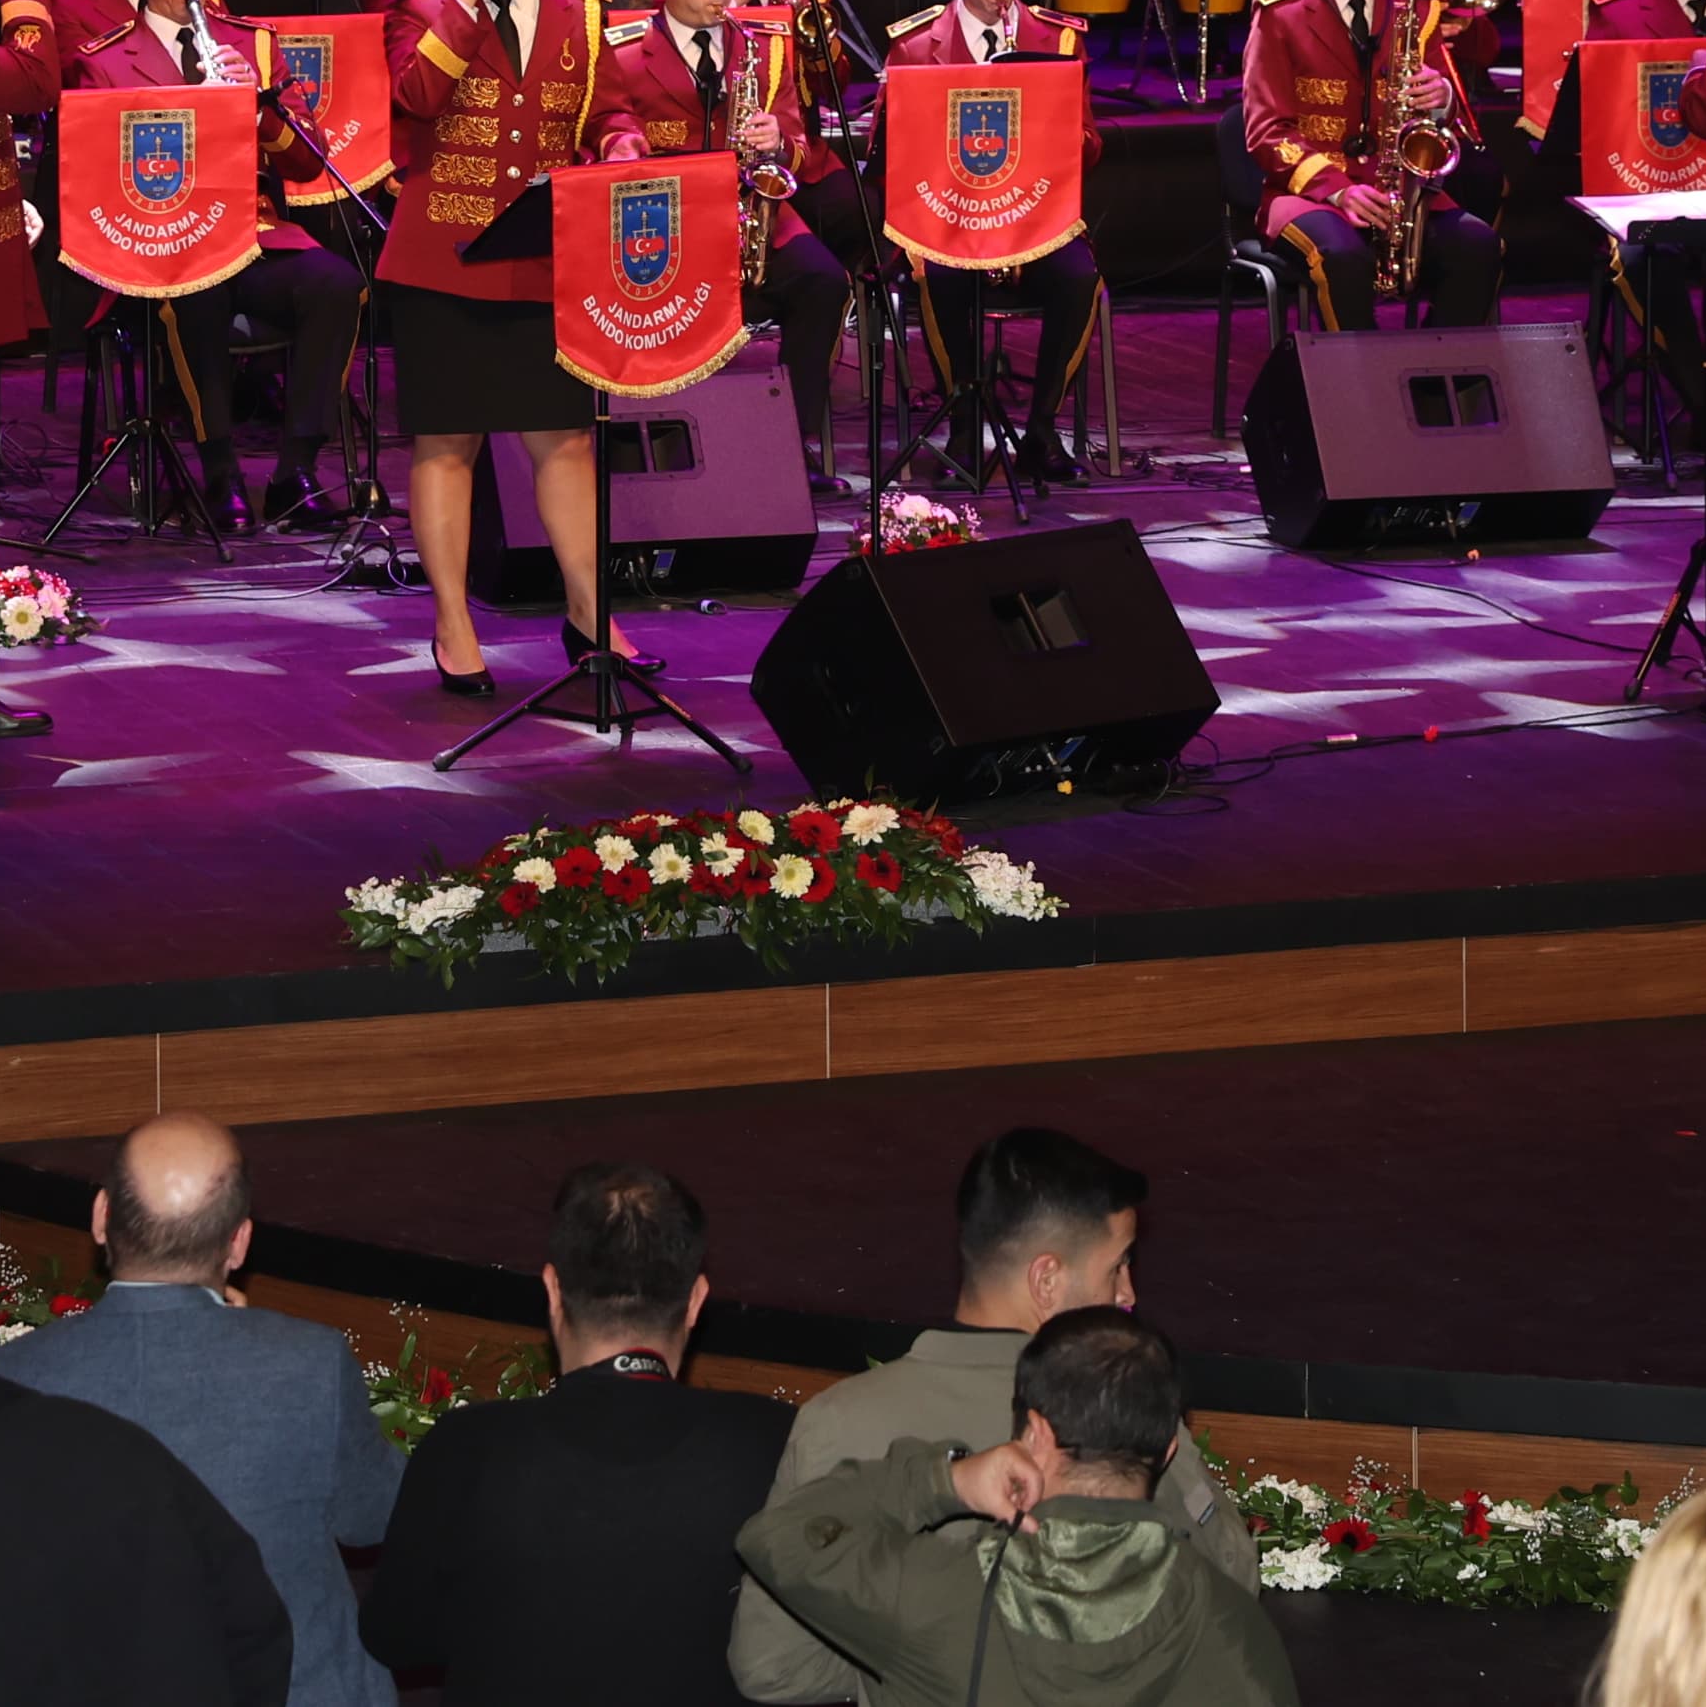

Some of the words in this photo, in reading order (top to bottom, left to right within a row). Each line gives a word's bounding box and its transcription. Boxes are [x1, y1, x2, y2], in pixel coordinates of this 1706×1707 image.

[1607, 152, 1650, 194] BANDO
[915, 180, 958, 224] BANDO
[959, 177, 1051, 230] KOMUTANLIĞI
[941, 185, 1025, 214] JANDARMA
[89, 206, 132, 251] BANDO
[133, 200, 227, 257] KOMUTANLIĞI
[114, 210, 200, 238] JANDARMA
[582, 295, 624, 345] BANDO
[625, 281, 712, 351] KOMUTANLIĞI
[607, 294, 687, 329] JANDARMA
